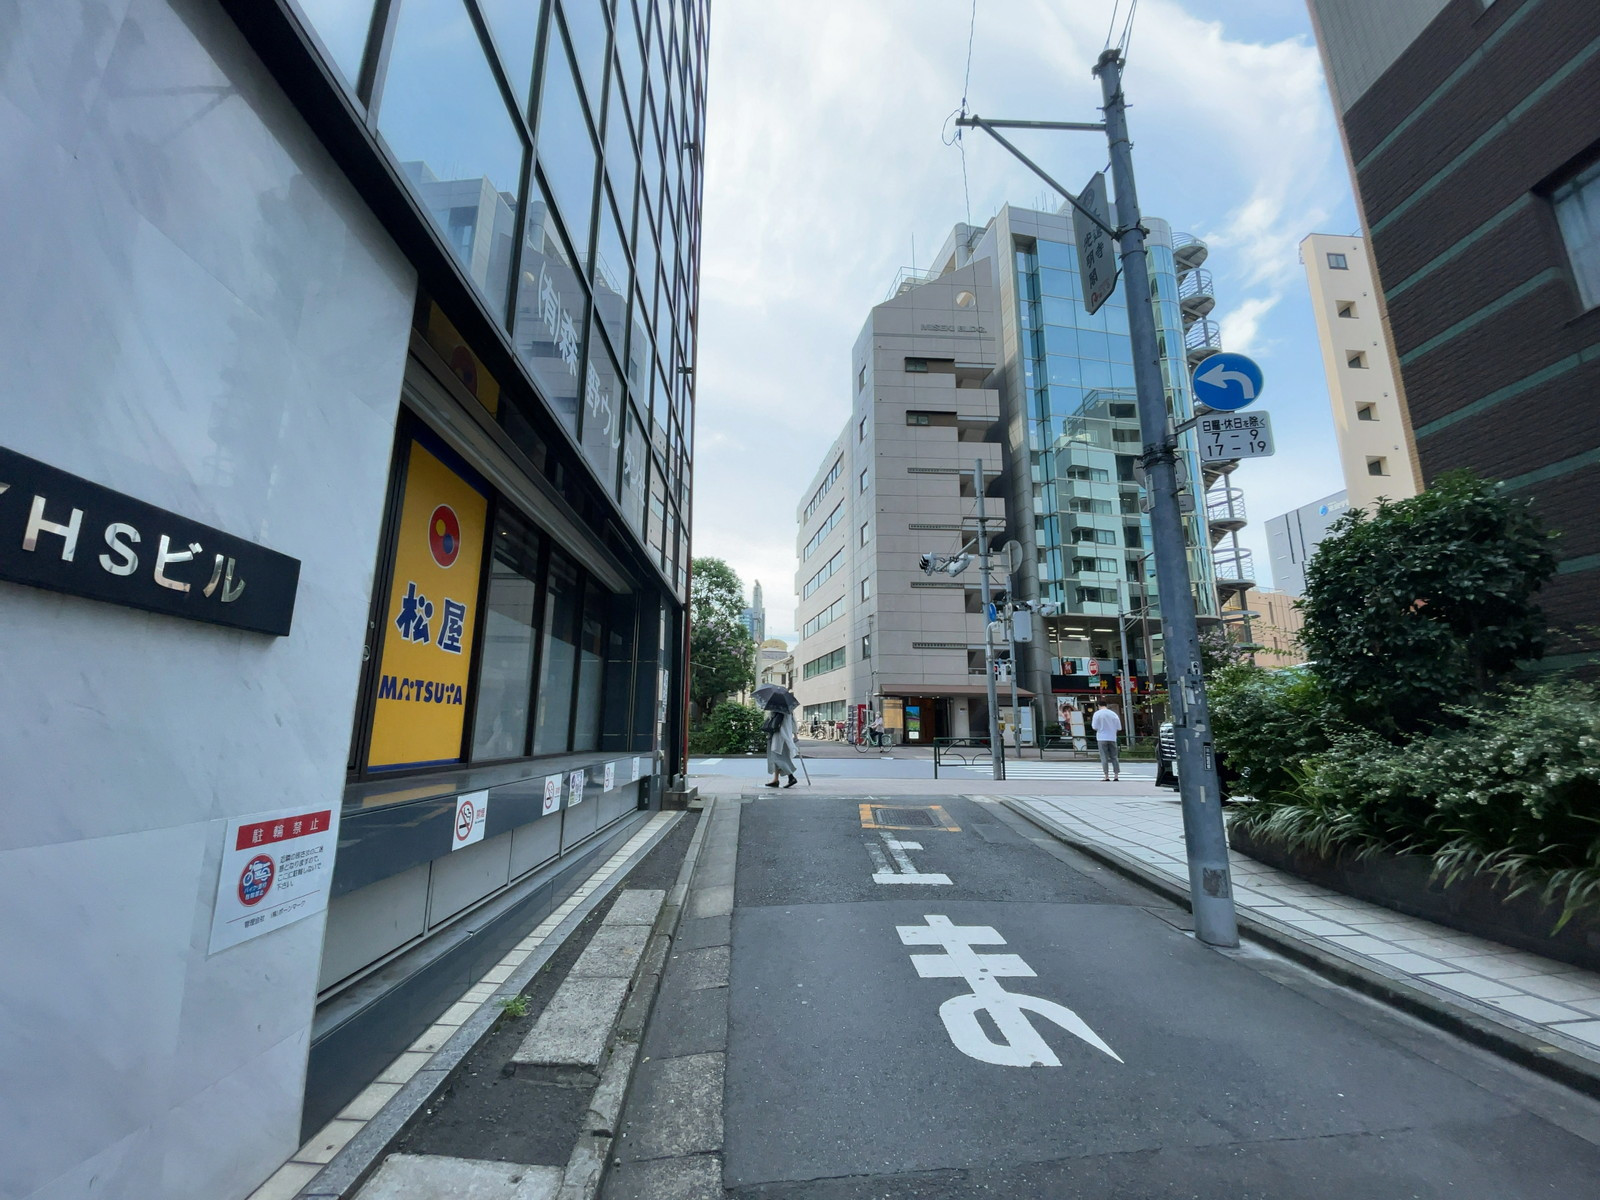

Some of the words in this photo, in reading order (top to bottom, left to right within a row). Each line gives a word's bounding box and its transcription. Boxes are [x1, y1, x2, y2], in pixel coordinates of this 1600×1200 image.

[1202, 416, 1265, 432] 日曜・休日を除く
[0, 482, 246, 603] HSビル
[395, 581, 467, 655] 松屋
[378, 675, 463, 706] MATSUYA
[252, 818, 319, 844] 駐輪禁止
